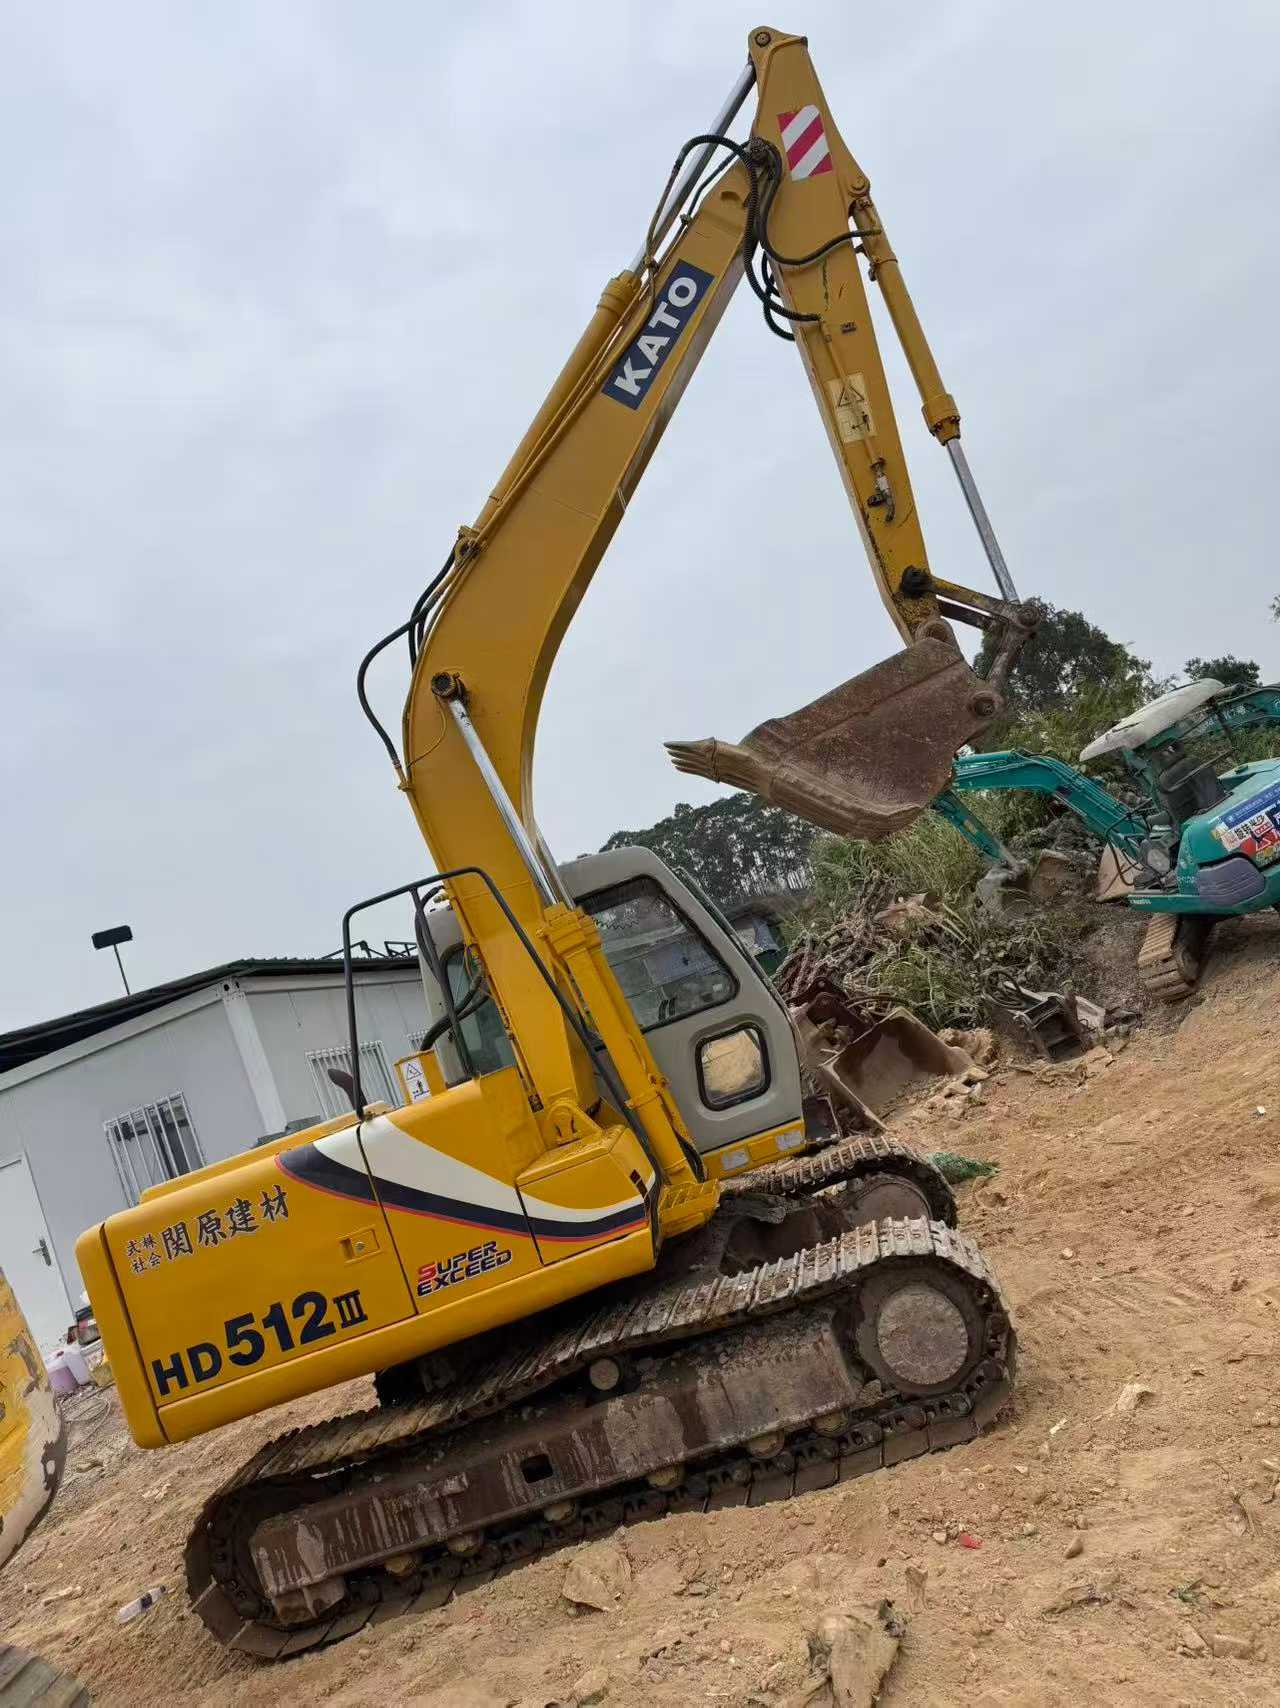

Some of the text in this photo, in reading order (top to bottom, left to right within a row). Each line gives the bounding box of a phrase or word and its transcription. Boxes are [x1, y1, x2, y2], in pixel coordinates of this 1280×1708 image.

[613, 276, 698, 396] KATO
[161, 1184, 289, 1260] 関原建材
[417, 1249, 512, 1296] EXCEED
[418, 1240, 497, 1281] SUPER
